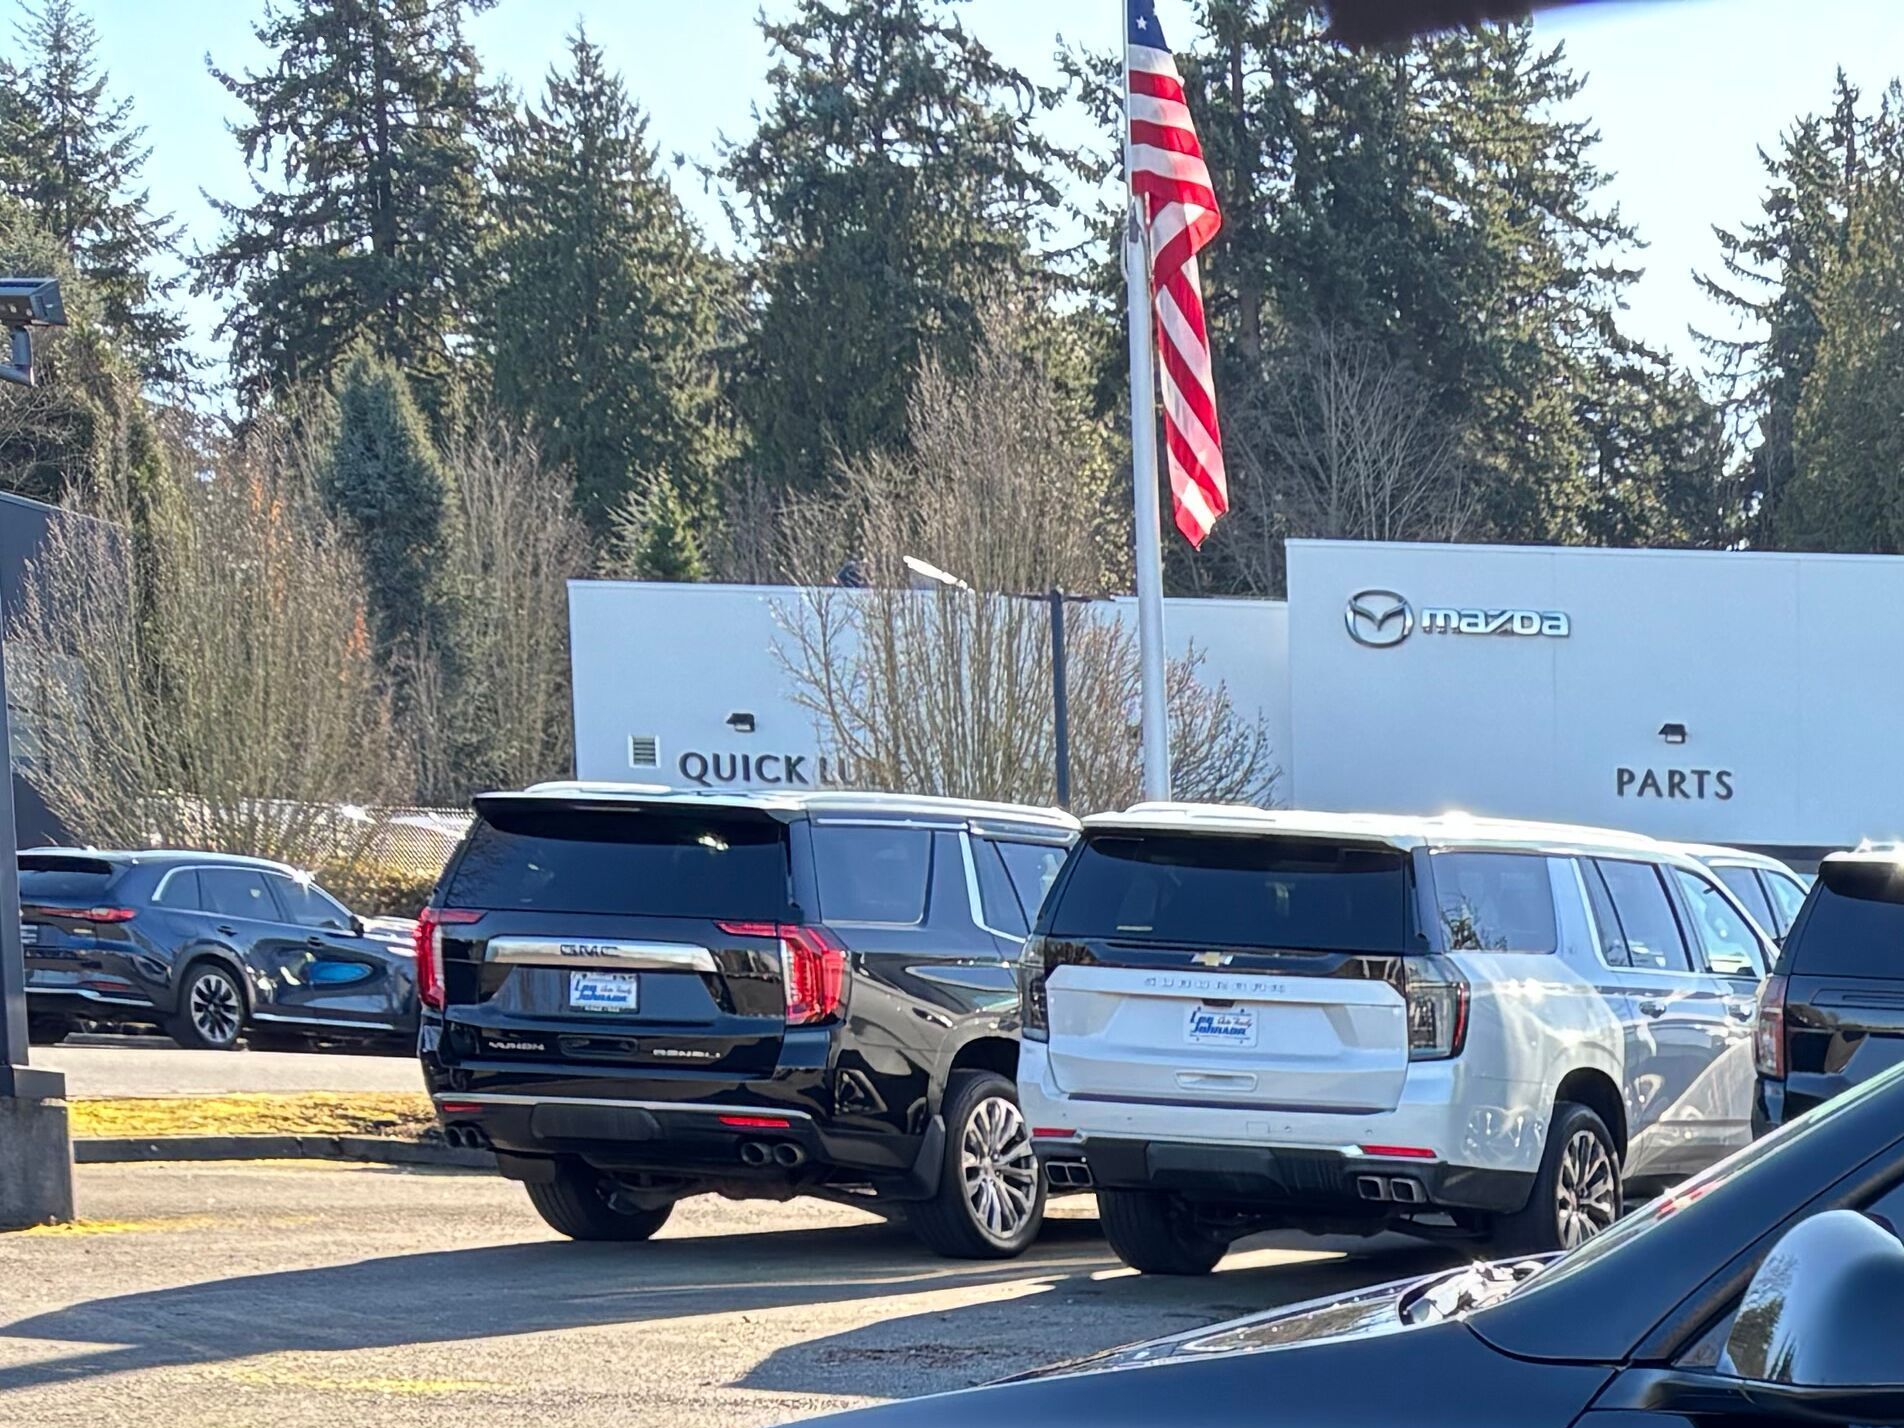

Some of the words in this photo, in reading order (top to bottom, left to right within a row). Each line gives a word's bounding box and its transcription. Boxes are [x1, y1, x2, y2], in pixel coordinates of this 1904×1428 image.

[679, 751, 809, 788] QUICK
[1616, 767, 1734, 801] PARTS
[559, 943, 621, 958] GMC
